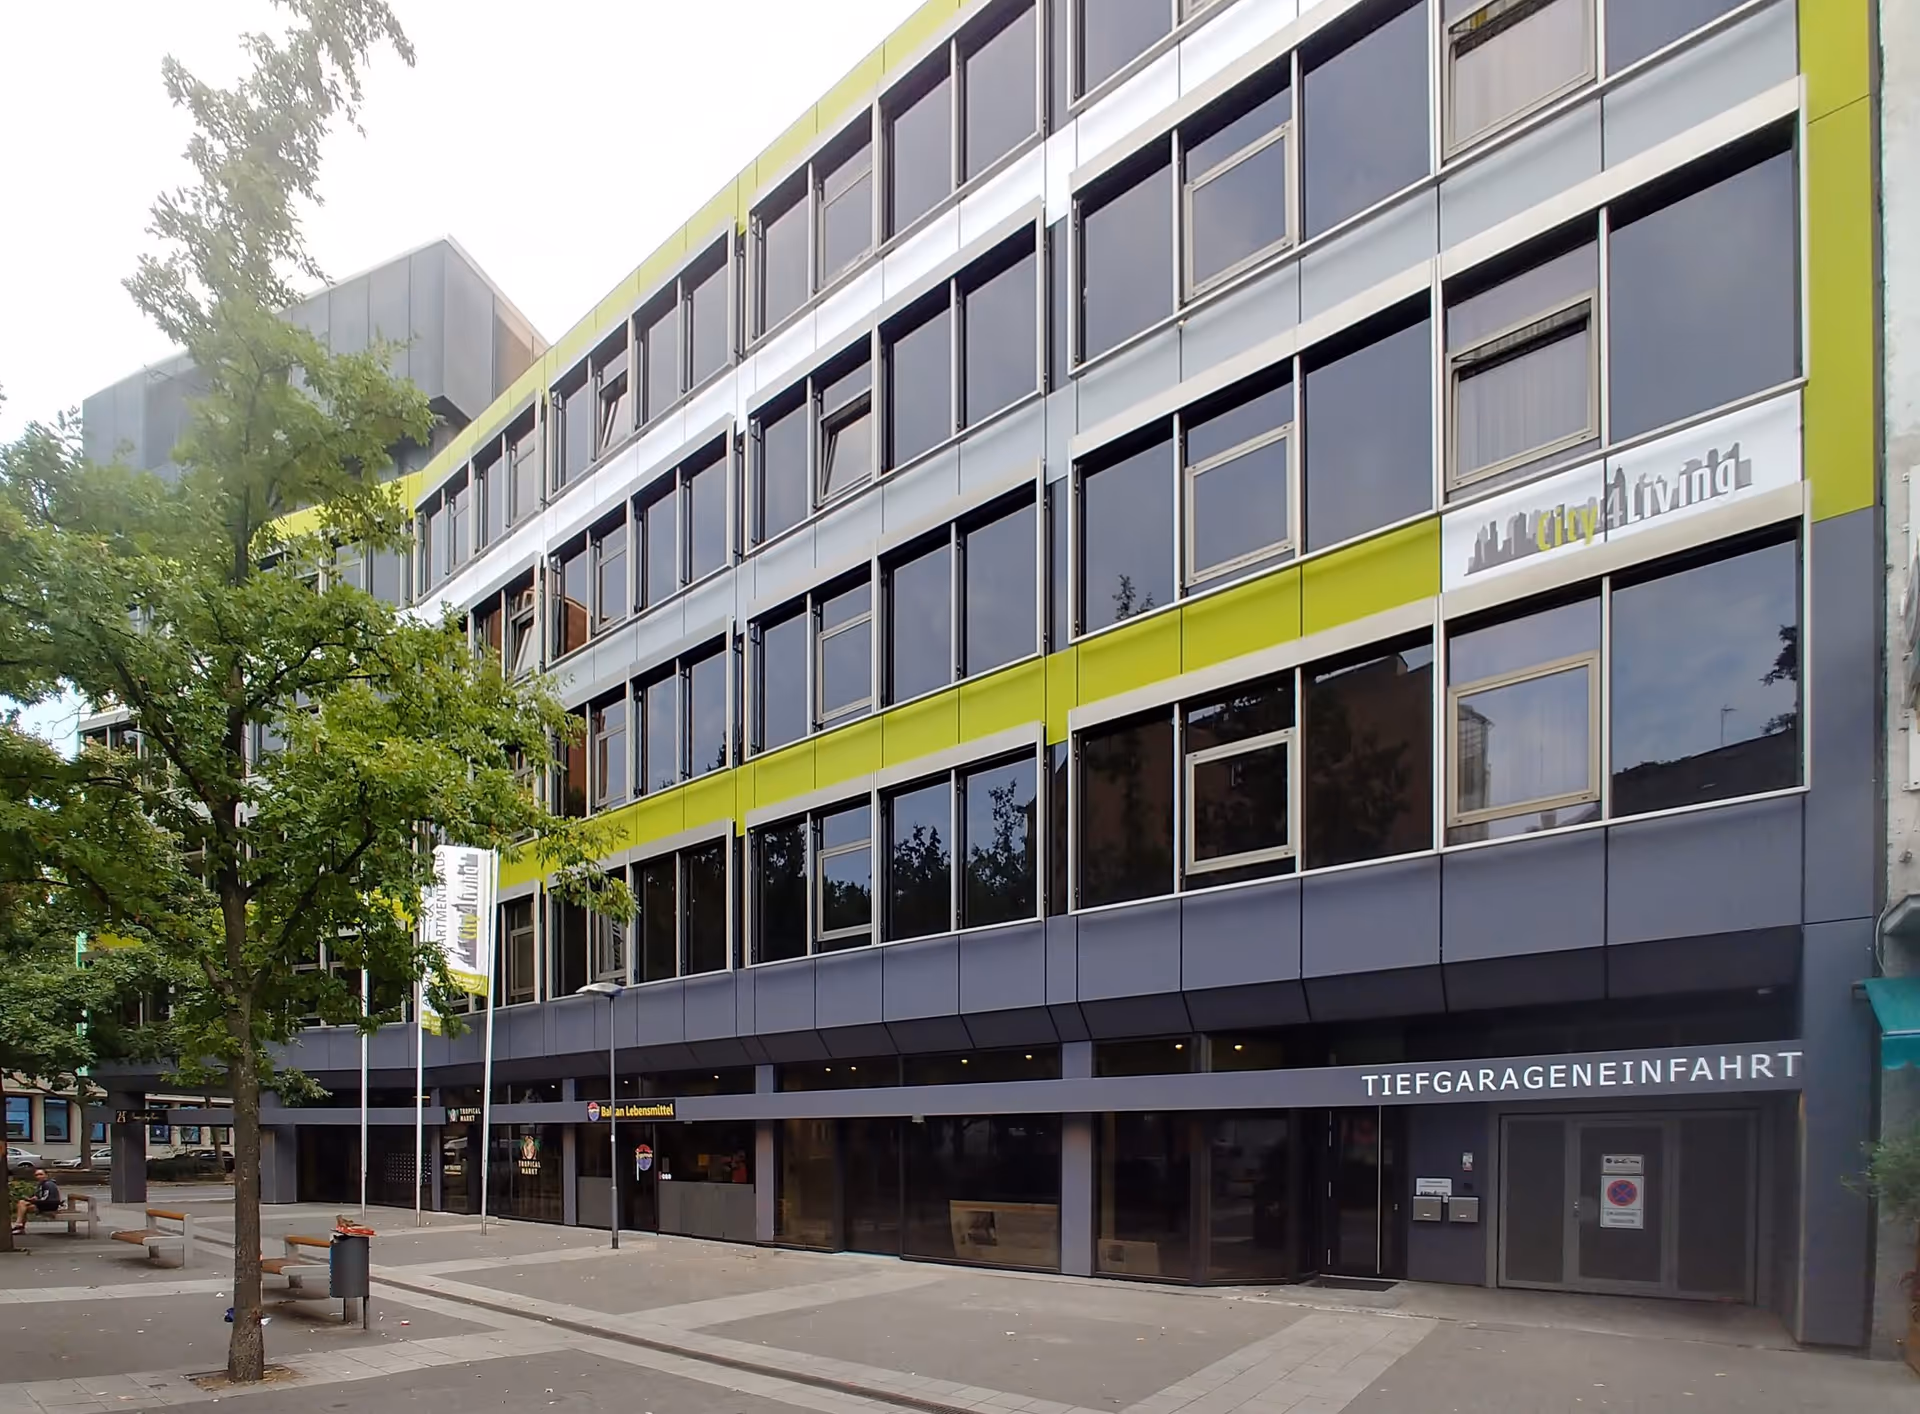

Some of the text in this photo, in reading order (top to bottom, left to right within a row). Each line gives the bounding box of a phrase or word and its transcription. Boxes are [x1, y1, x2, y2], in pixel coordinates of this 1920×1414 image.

[1360, 1051, 1803, 1097] TIEFGARAGENEINFAHRT
[460, 1107, 482, 1115] TROPICAL
[601, 1103, 674, 1117] Balan Lebensmittel
[518, 1160, 541, 1168] TROPICAL
